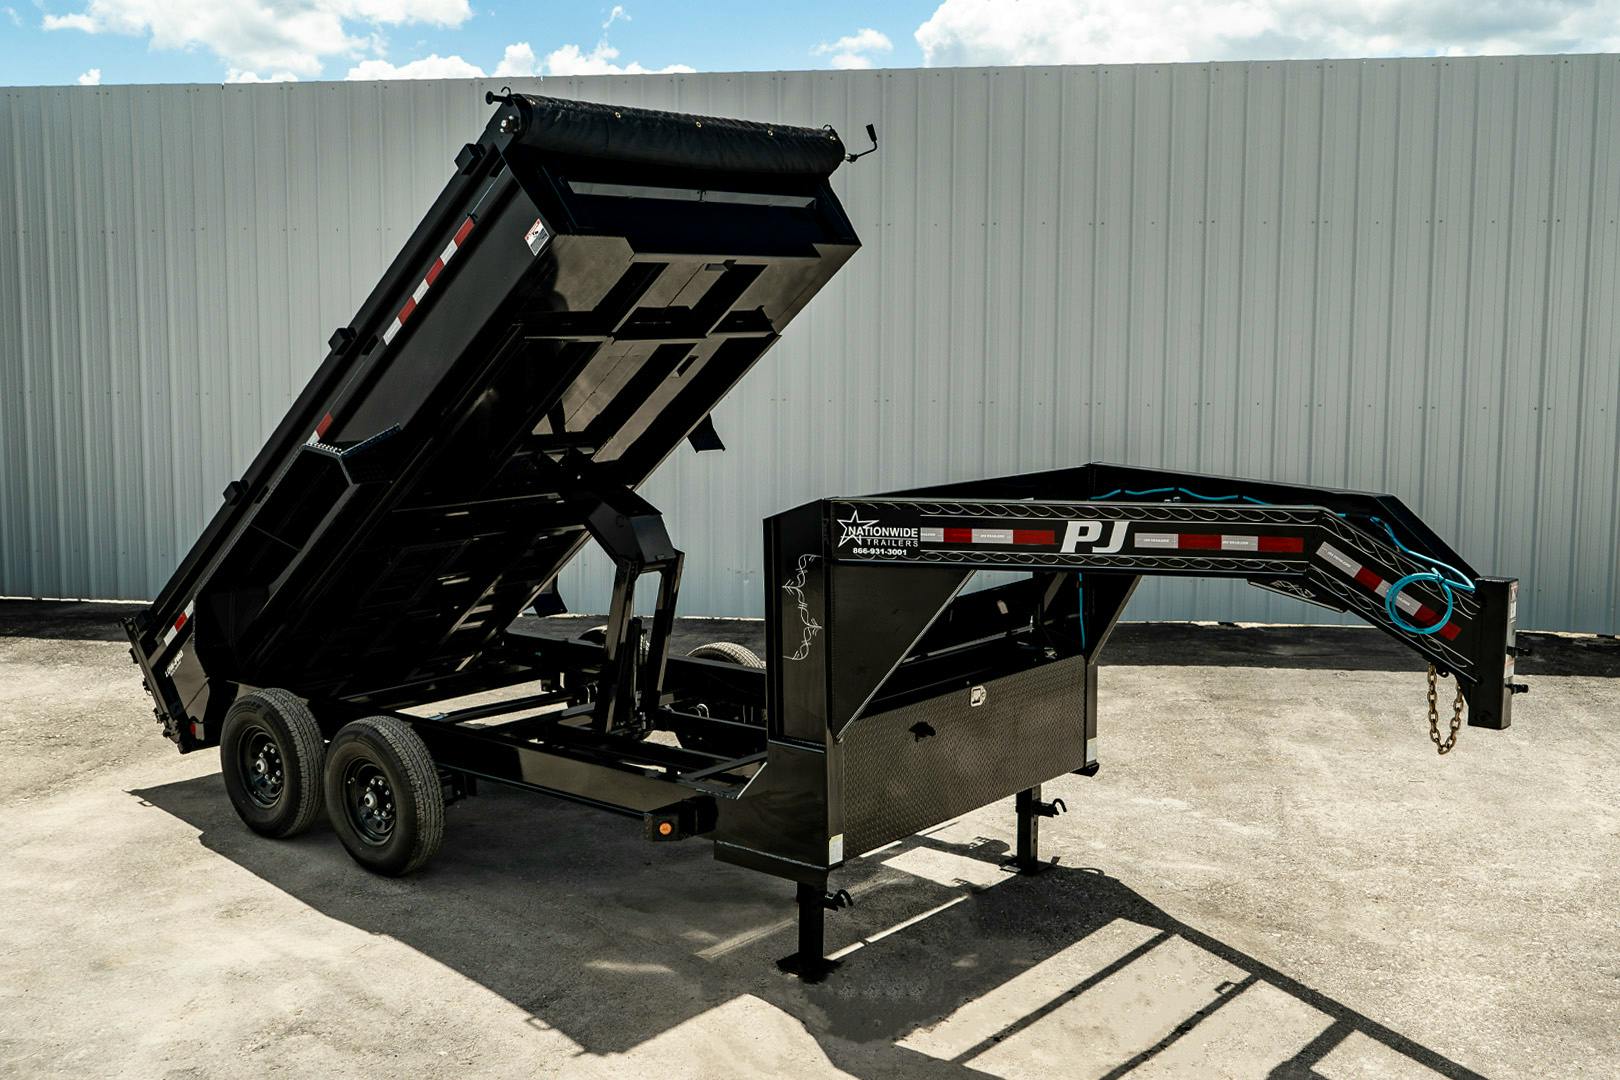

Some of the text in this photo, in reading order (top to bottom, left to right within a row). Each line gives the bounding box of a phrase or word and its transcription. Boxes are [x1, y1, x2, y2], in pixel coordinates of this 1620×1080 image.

[848, 526, 919, 538] NATIONWIDE
[1060, 520, 1132, 554] PJ
[866, 538, 919, 547] TRAILERS
[852, 547, 908, 556] 866-931-3001
